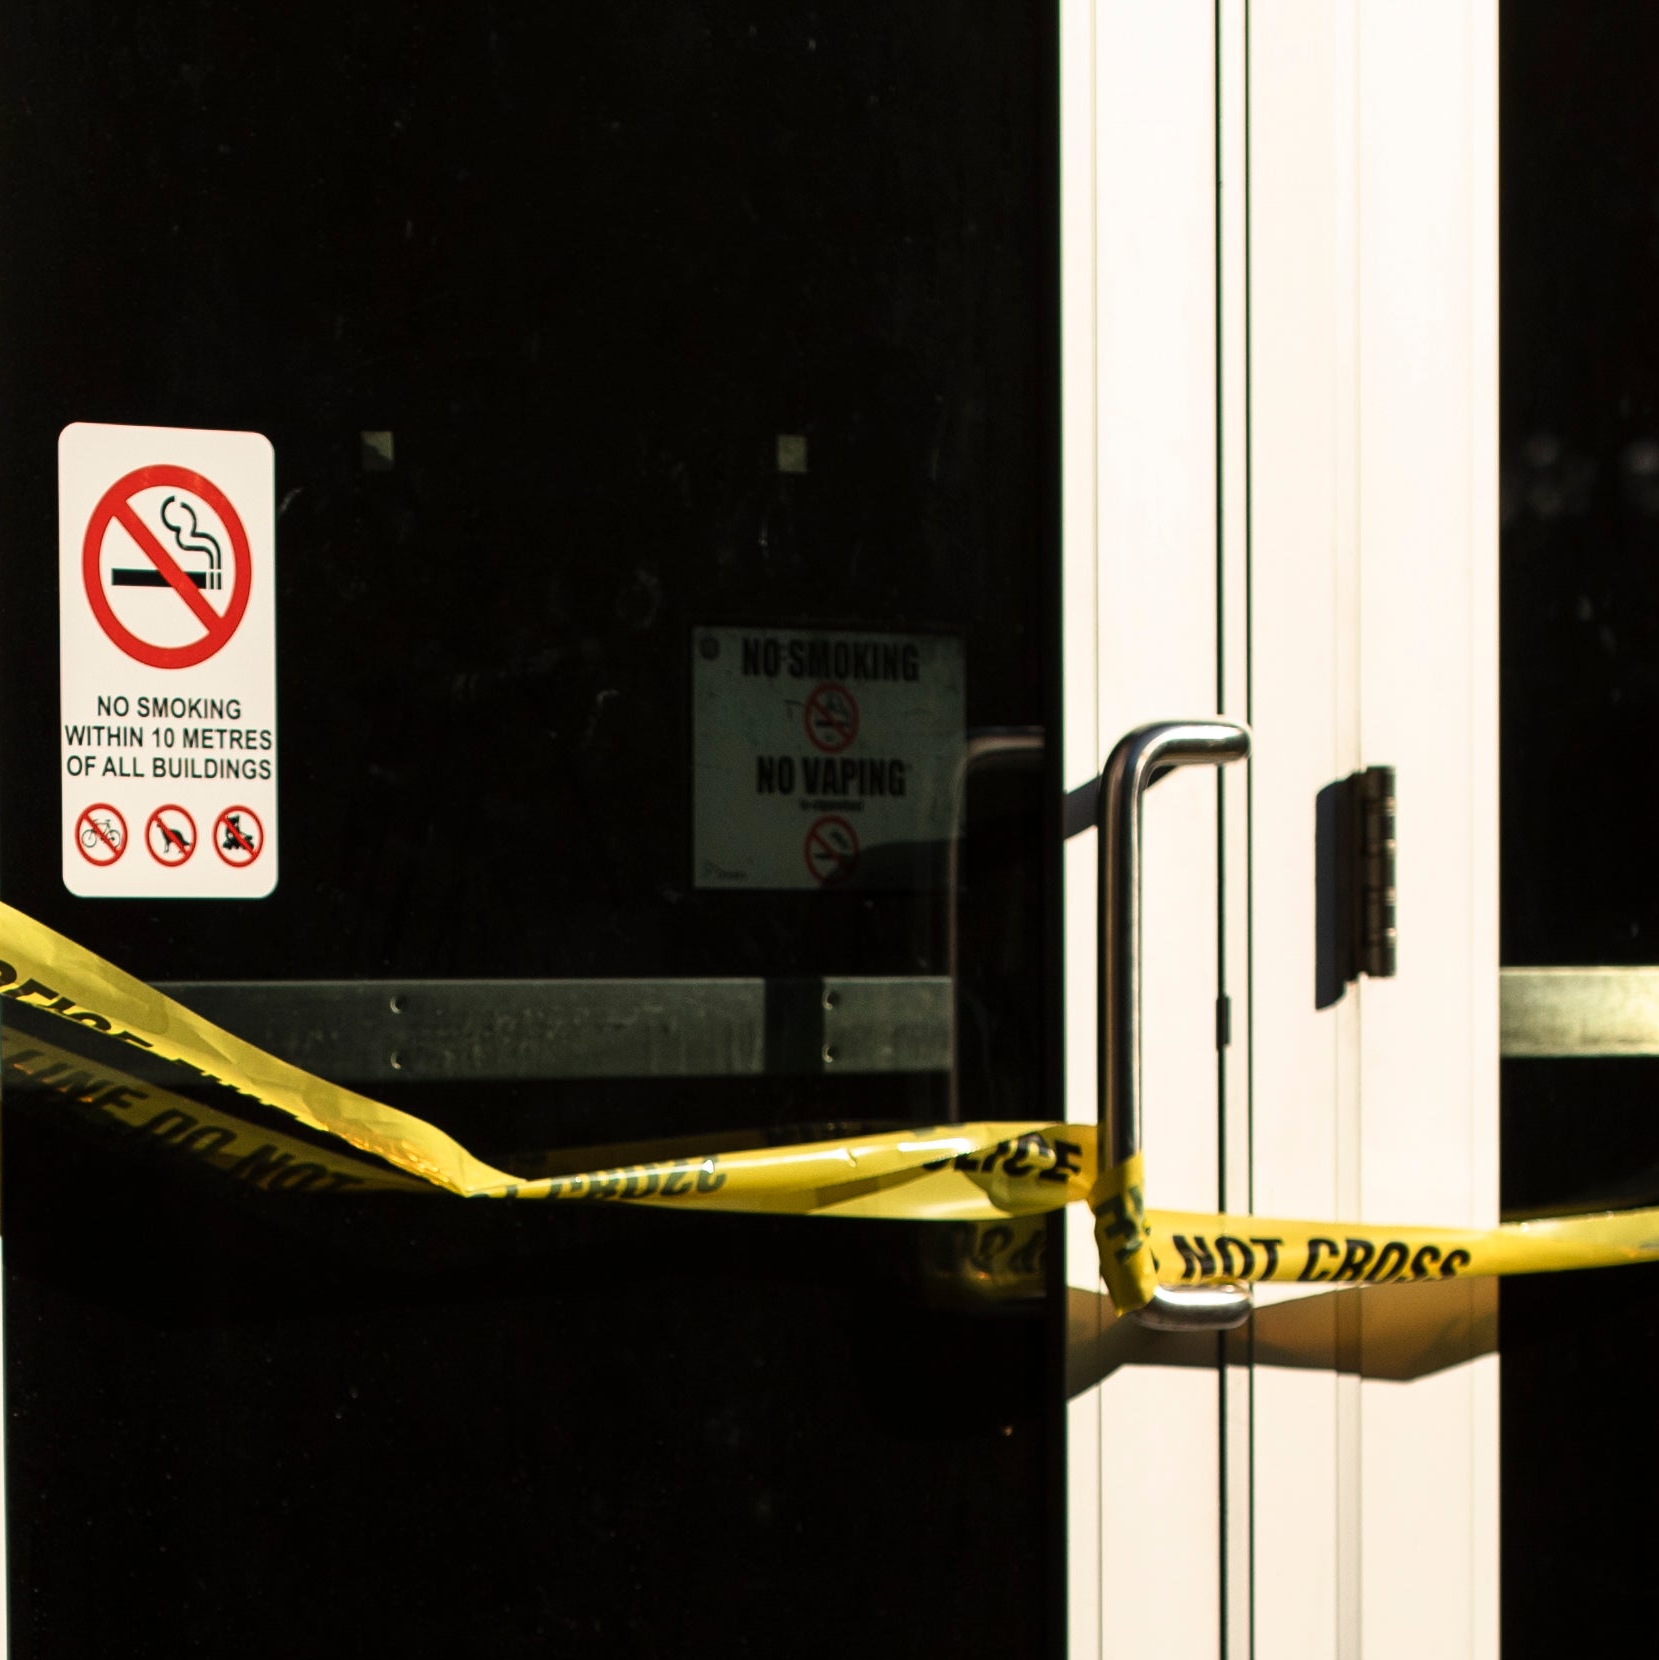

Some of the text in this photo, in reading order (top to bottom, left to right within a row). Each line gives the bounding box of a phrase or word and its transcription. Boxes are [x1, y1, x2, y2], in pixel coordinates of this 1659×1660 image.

[743, 638, 920, 682] NO SMOKING
[97, 696, 242, 720] NO SMOKING
[65, 725, 272, 751] WITHIN 10 METRES
[67, 756, 272, 781] OF ALL BUILDINGS
[756, 755, 906, 797] NO VAPING
[1171, 1234, 1471, 1284] NOT CROSS
